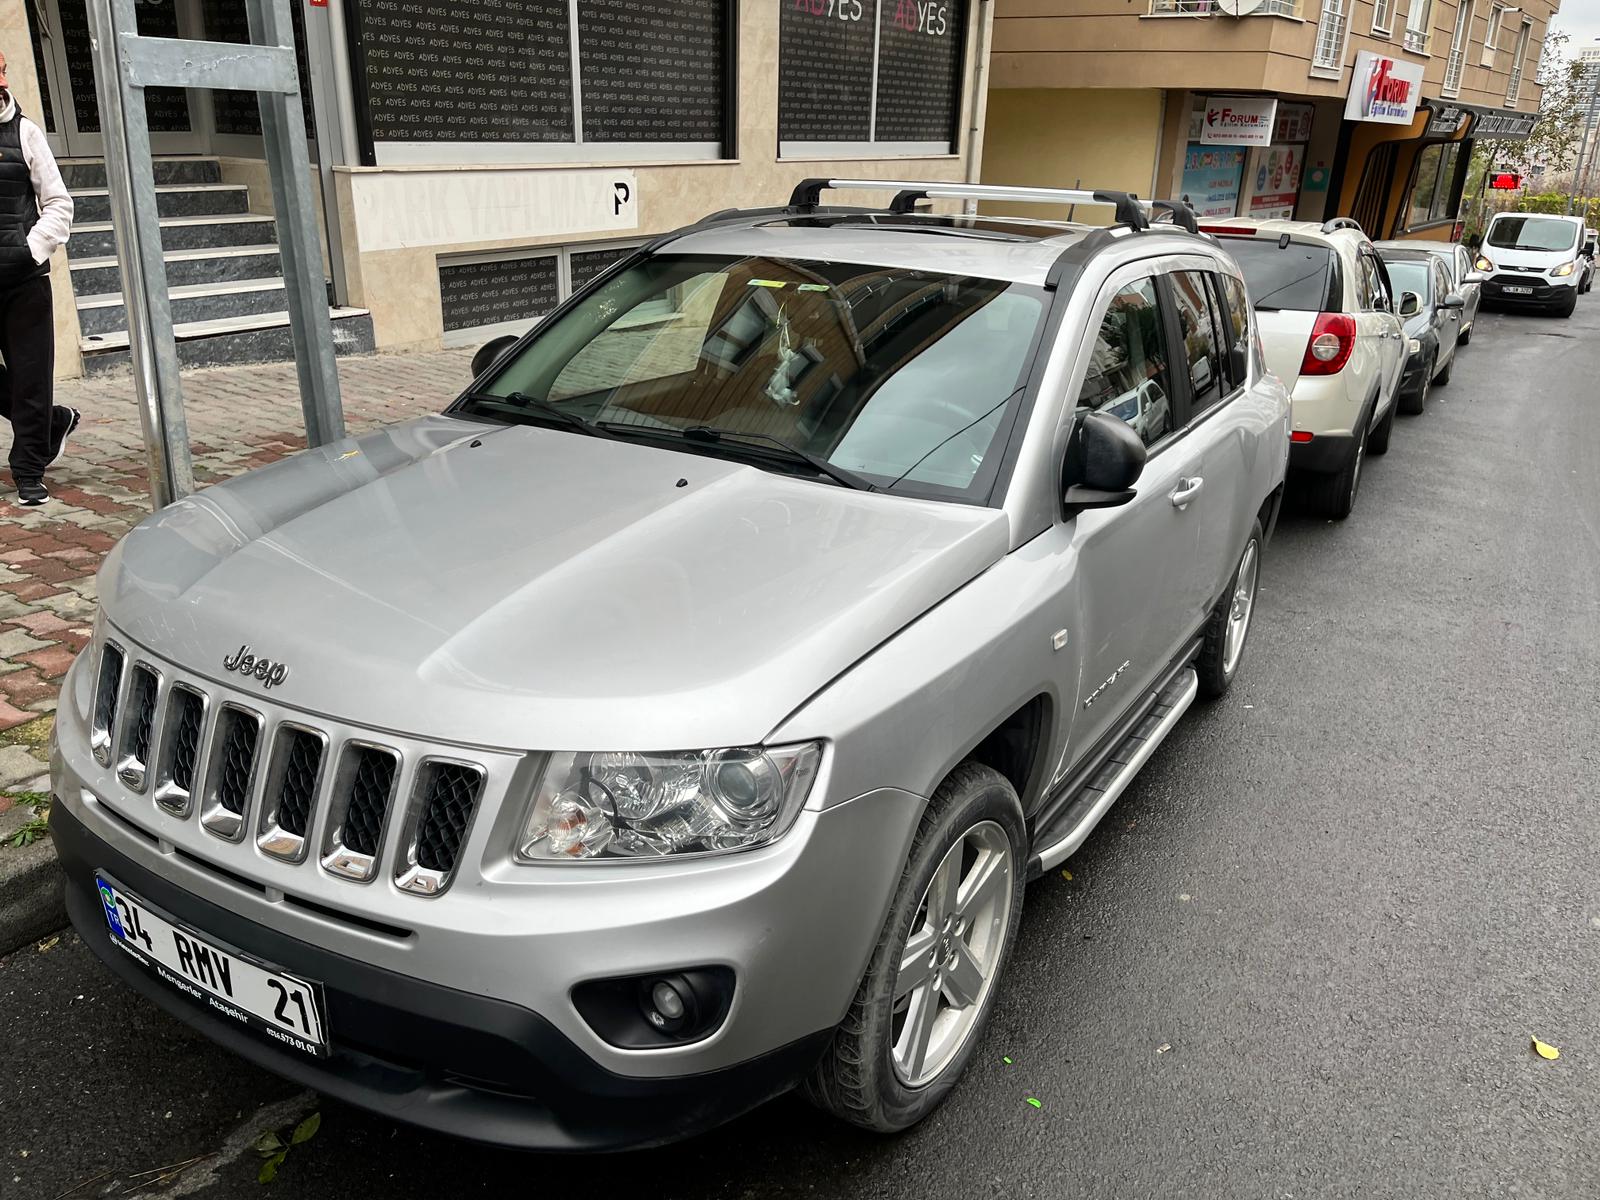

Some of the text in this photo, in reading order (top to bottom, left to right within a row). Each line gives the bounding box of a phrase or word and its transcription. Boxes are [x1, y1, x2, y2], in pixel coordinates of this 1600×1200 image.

[376, 1, 398, 11] ADYES
[401, 4, 423, 14] ADYES
[426, 6, 447, 17] ADYES
[450, 9, 470, 19] ADYES
[473, 12, 492, 22] ADYES
[495, 15, 514, 24] ADYES
[516, 18, 534, 26] ADYES
[505, 2, 523, 11] ADYES
[526, 4, 543, 13] ADYES
[894, 0, 948, 36] ADYES
[364, 16, 387, 26] ADYES
[390, 18, 412, 28] ADYES
[416, 21, 437, 31] ADYES
[440, 24, 460, 34] ADYES
[463, 26, 482, 36] ADYES
[485, 29, 504, 38] ADYES
[507, 31, 524, 40] ADYES
[527, 34, 544, 42] ADYES
[379, 33, 401, 43] ADYES
[404, 36, 426, 46] ADYES
[429, 38, 450, 48] ADYES
[452, 41, 472, 50] ADYES
[475, 43, 494, 52] ADYES
[497, 45, 515, 54] ADYES
[518, 47, 536, 56] ADYES
[367, 49, 390, 58] ADYES
[393, 51, 415, 60] ADYES
[418, 53, 439, 62] ADYES
[442, 55, 462, 64] ADYES
[465, 57, 484, 66] ADYES
[487, 59, 506, 68] ADYES
[509, 61, 526, 69] ADYES
[529, 62, 546, 71] ADYES
[382, 66, 404, 76] ADYES
[407, 68, 428, 77] ADYES
[432, 70, 452, 79] ADYES
[455, 71, 474, 80] ADYES
[477, 73, 496, 82] ADYES
[498, 74, 517, 83] ADYES
[519, 76, 537, 84] ADYES
[370, 81, 392, 90] ADYES
[396, 82, 418, 92] ADYES
[421, 84, 441, 93] ADYES
[444, 86, 464, 94] ADYES
[467, 87, 486, 96] ADYES
[489, 88, 508, 97] ADYES
[510, 89, 528, 98] ADYES
[385, 98, 407, 107] ADYES
[410, 99, 431, 108] ADYES
[434, 100, 454, 109] ADYES
[457, 101, 476, 110] ADYES
[479, 102, 498, 111] ADYES
[500, 103, 518, 112] ADYES
[374, 113, 396, 122] ADYES
[399, 114, 420, 123] ADYES
[424, 115, 444, 124] ADYES
[447, 116, 466, 124] ADYES
[469, 116, 488, 125] ADYES
[491, 117, 509, 125] ADYES
[512, 117, 530, 126] ADYES
[1221, 108, 1260, 124] FORUM
[388, 129, 410, 138] ADYES
[413, 130, 433, 138] ADYES
[436, 130, 456, 138] ADYES
[459, 130, 478, 139] ADYES
[481, 131, 500, 139] ADYES
[502, 131, 520, 140] ADYES
[522, 132, 540, 140] ADYES
[223, 644, 289, 689] Jeep
[108, 910, 121, 926] TR
[114, 896, 311, 1036] 34 RMV 21
[209, 998, 249, 1024] Ataşehir
